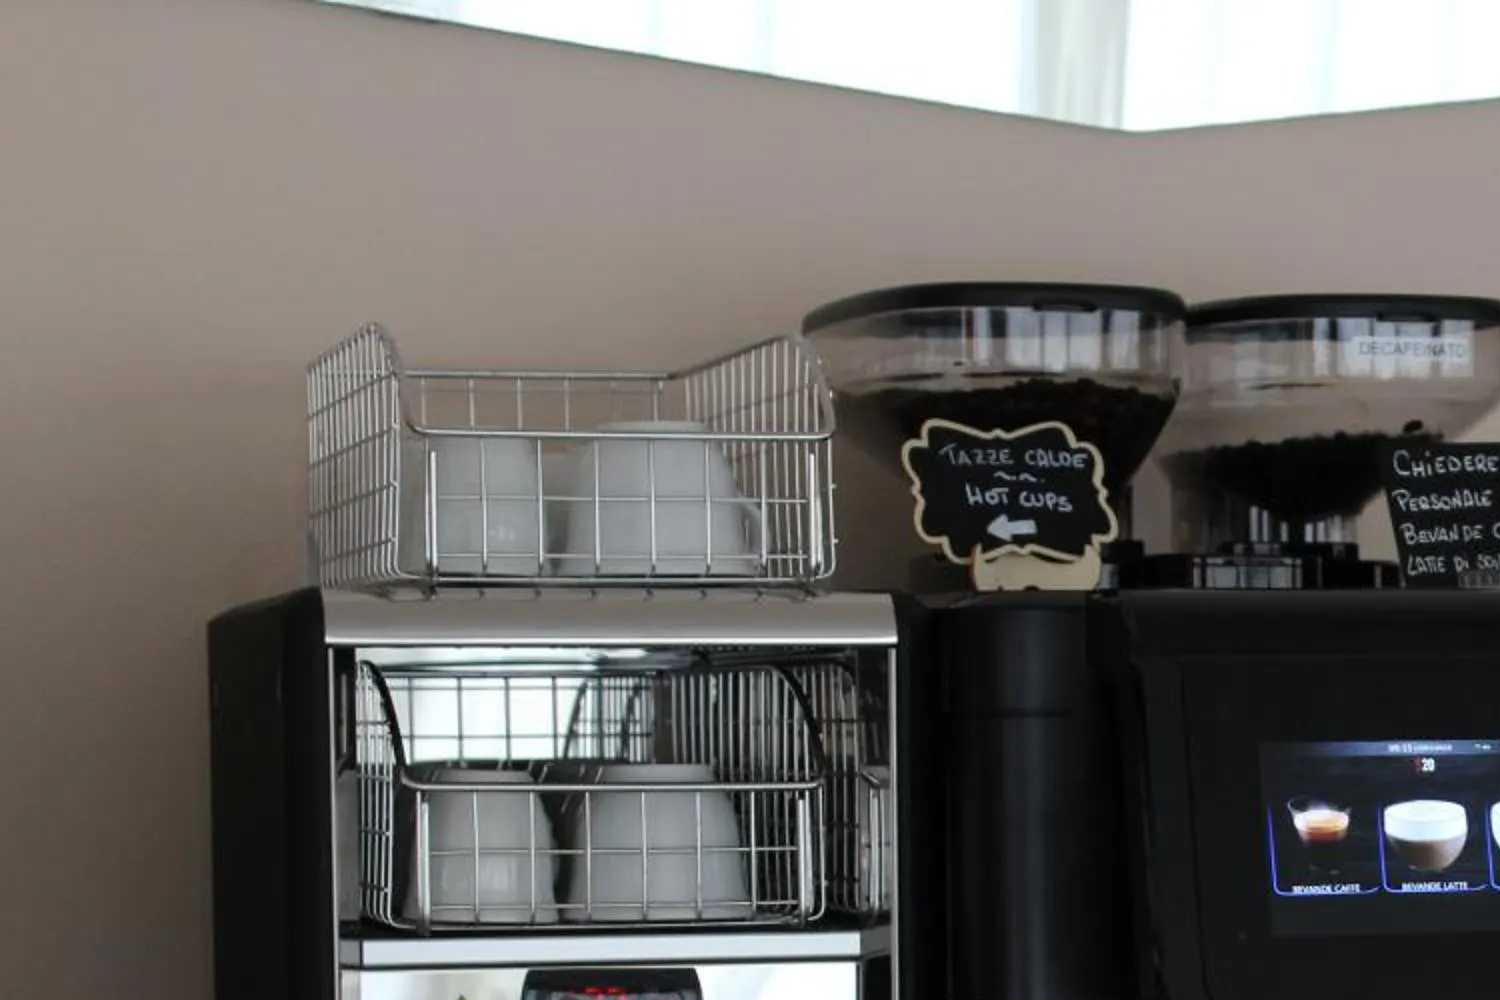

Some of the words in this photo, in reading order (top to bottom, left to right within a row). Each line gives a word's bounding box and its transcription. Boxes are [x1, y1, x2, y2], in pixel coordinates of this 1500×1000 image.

[938, 443, 1014, 465] TAZZE
[965, 482, 1010, 506] HOT
[1019, 491, 1073, 512] CUPS
[1391, 488, 1493, 512] PERSONALE
